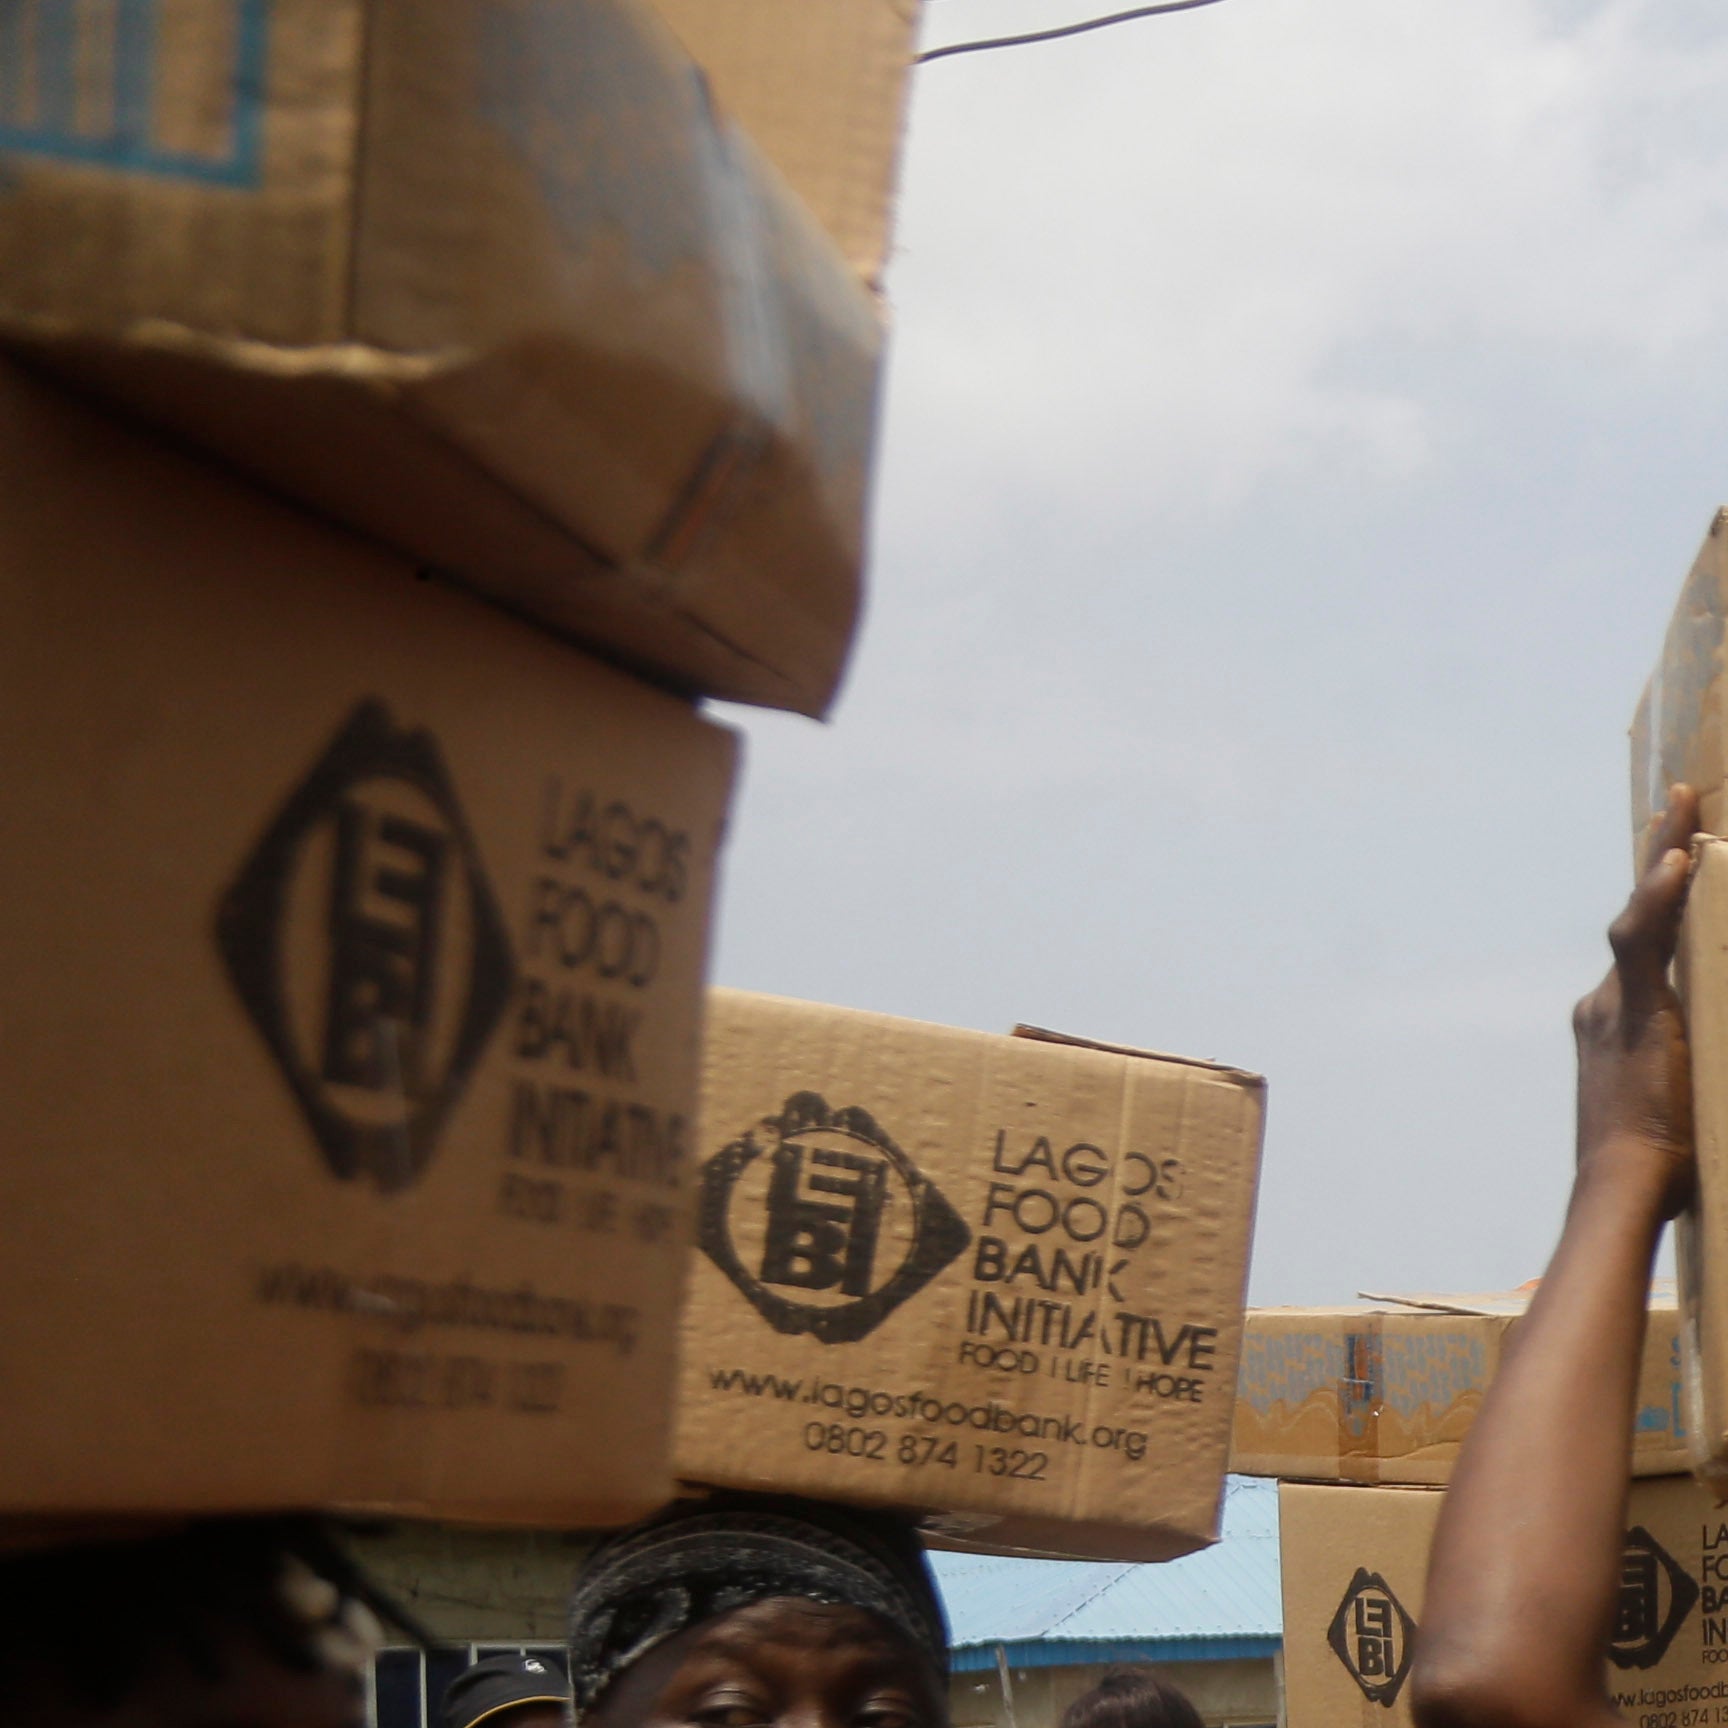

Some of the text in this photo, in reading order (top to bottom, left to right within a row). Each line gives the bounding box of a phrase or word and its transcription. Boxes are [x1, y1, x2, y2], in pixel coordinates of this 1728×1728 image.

[992, 1128, 1185, 1201] LAGOS
[982, 1181, 1152, 1250] FOOD
[973, 1235, 1130, 1303] BANK
[966, 1289, 1219, 1371] INITIATIVE
[958, 1340, 1040, 1375] FOOD
[1135, 1371, 1207, 1404] HOPE
[804, 1421, 1050, 1482] 0802 874 1322
